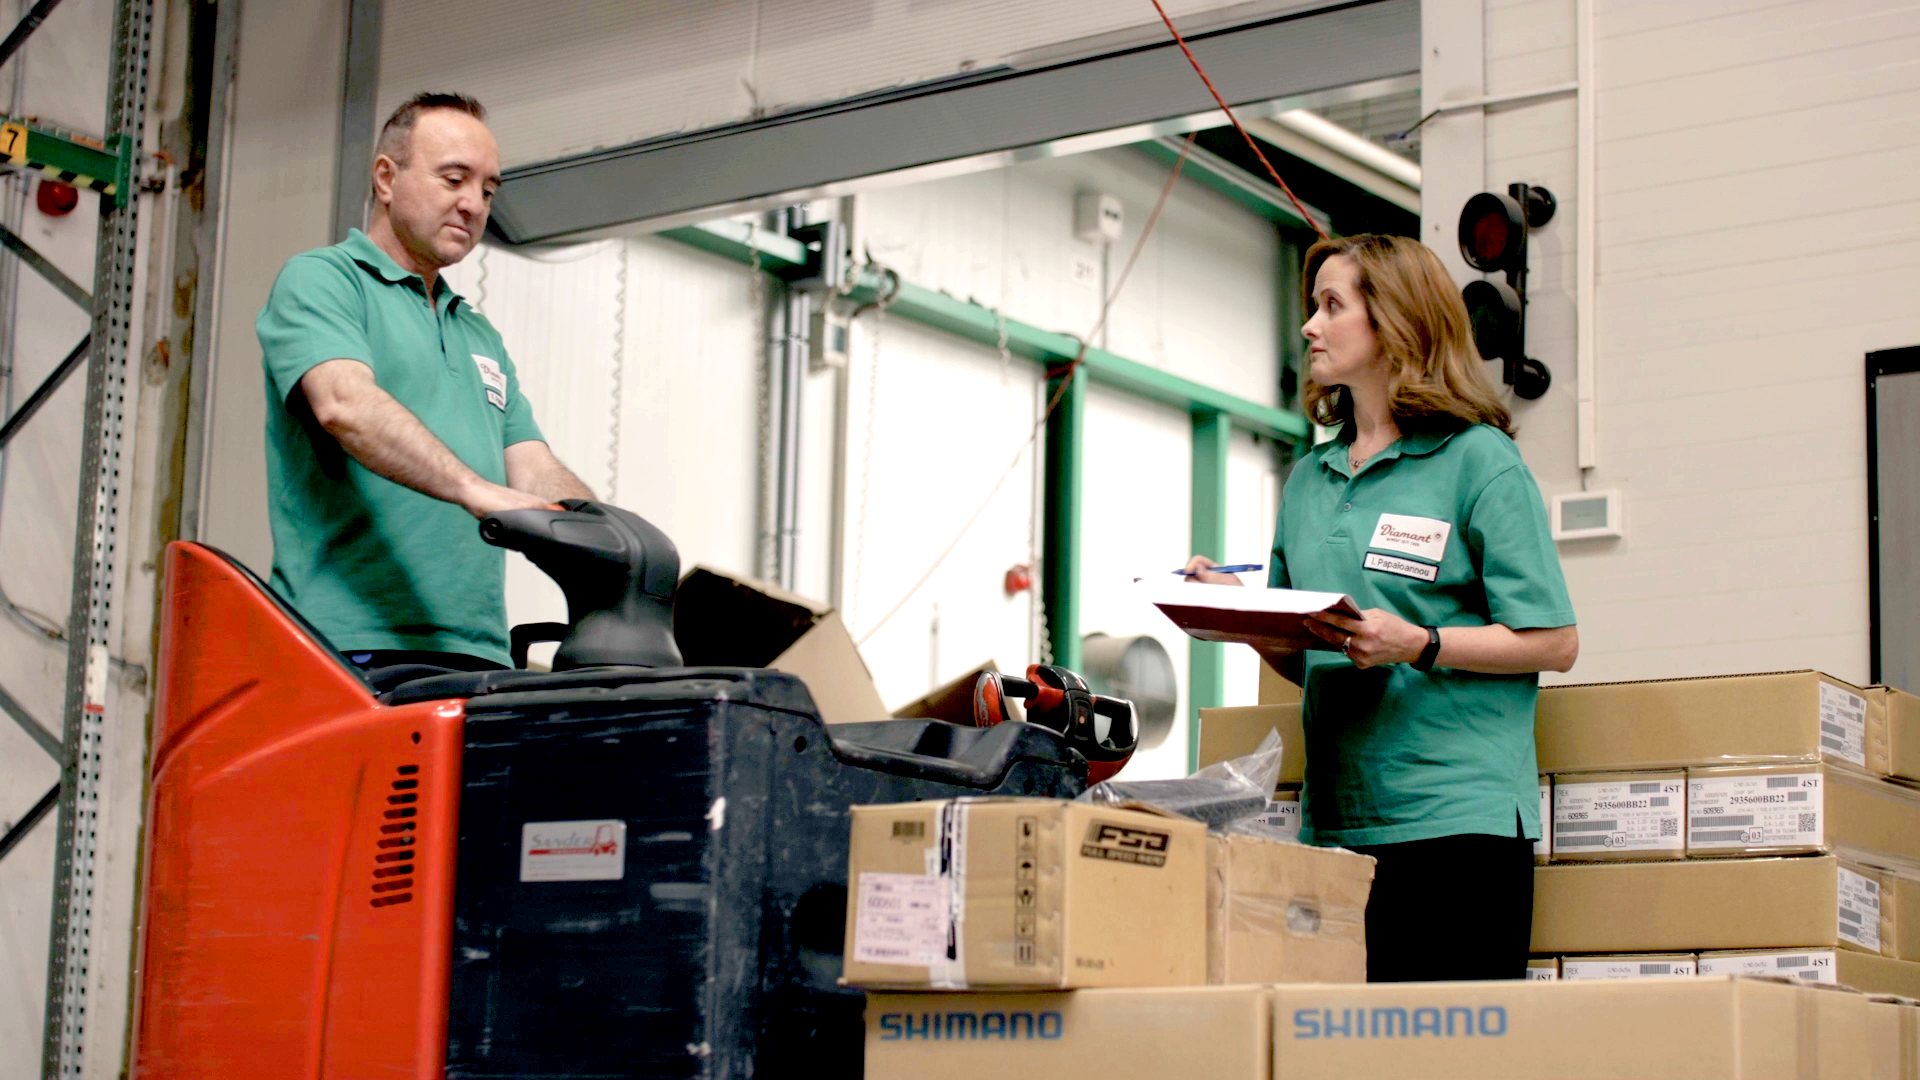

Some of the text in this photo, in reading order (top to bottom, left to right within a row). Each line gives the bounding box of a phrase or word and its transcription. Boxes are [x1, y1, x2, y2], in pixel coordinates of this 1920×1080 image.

[6, 127, 19, 153] 7
[1380, 524, 1432, 543] Diamant
[1377, 558, 1430, 577] Papaioannou
[1801, 779, 1818, 788] 4ST
[1663, 785, 1681, 793] 4ST
[1729, 794, 1785, 805] 2935600BB22
[1594, 800, 1648, 810] 2935600BB22
[1281, 806, 1297, 814] 4ST
[1751, 831, 1761, 840] 03
[1614, 836, 1624, 845] 03
[1811, 958, 1830, 967] 4ST
[1673, 967, 1692, 976] 4ST
[880, 1012, 1063, 1041] SHIMANO
[1293, 1006, 1507, 1039] SHIMANO
